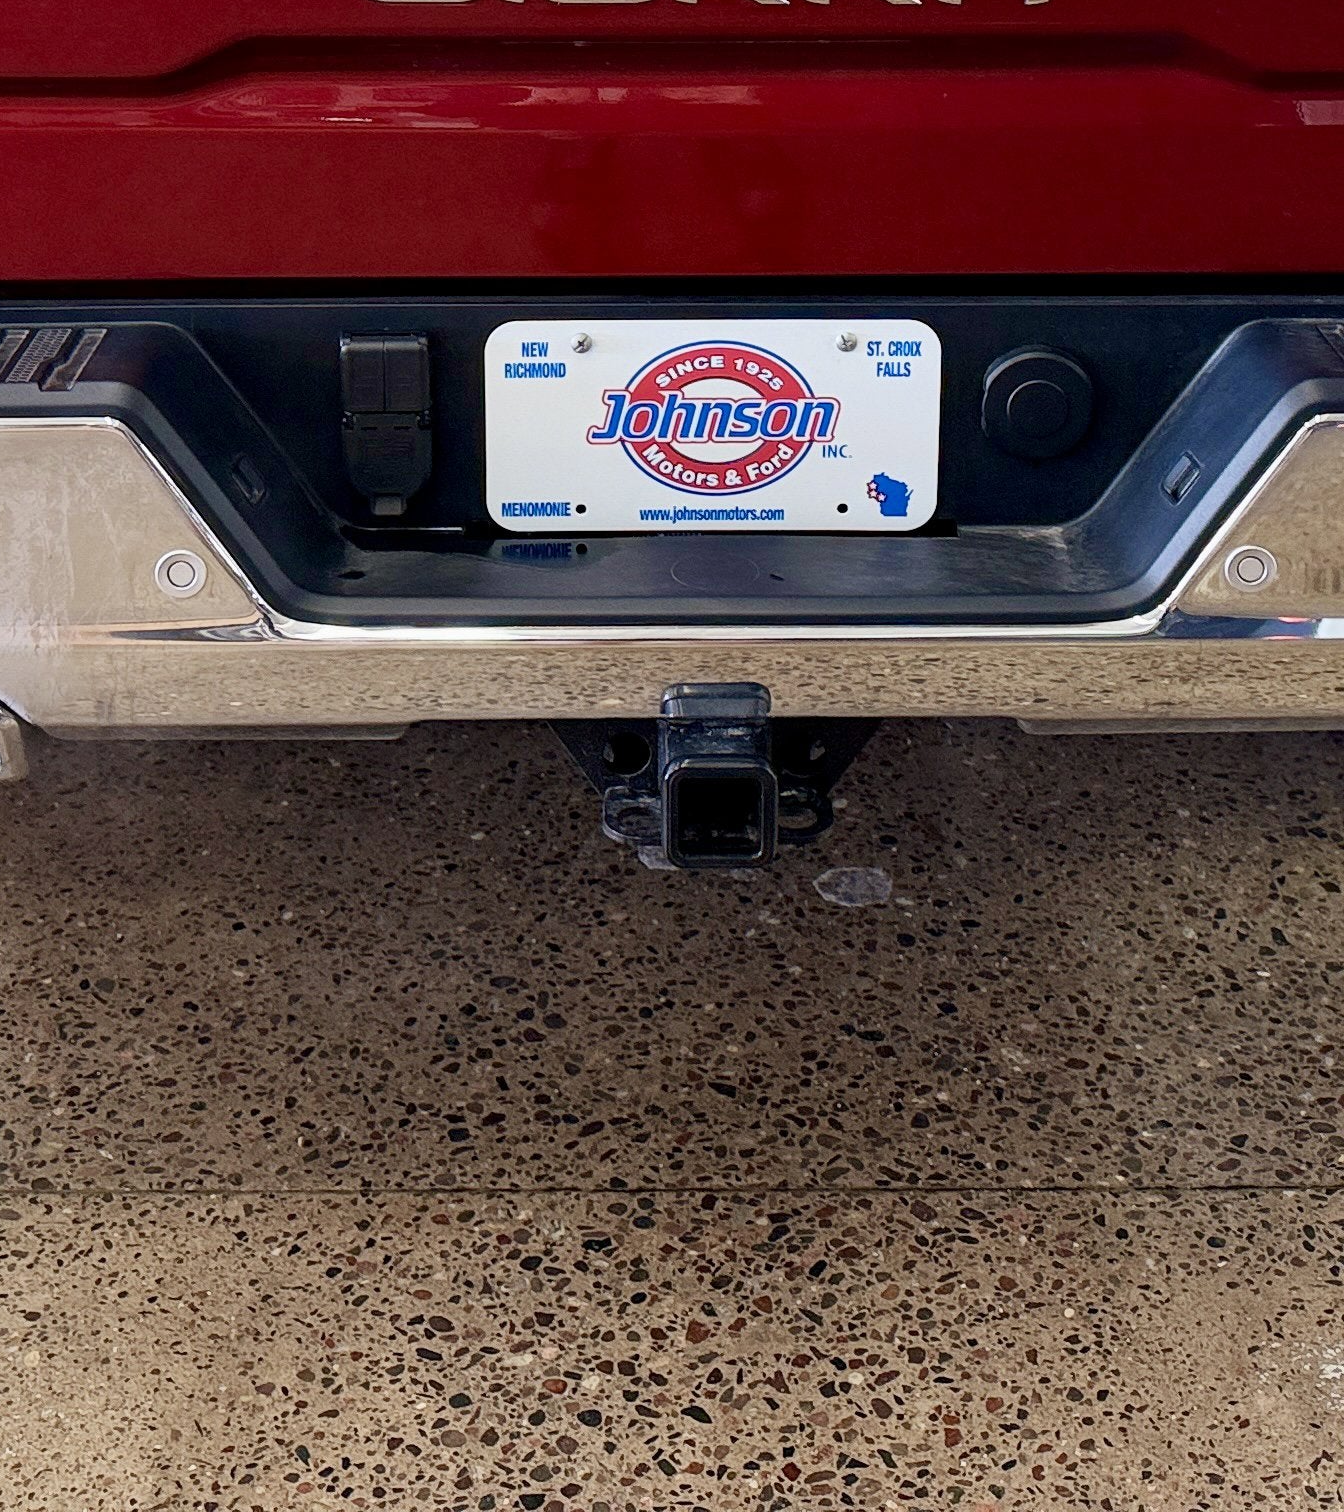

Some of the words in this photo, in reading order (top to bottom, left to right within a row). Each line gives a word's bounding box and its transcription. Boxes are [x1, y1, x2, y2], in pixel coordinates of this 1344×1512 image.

[521, 341, 549, 358] NEW
[866, 341, 885, 357] ST.
[887, 340, 922, 357] CROIX
[504, 362, 567, 379] RICHMOND
[655, 355, 726, 389] SINCE
[733, 357, 785, 392] 1925
[876, 361, 911, 378] FALLS
[589, 392, 837, 441] Johnson
[822, 444, 853, 459] INC.
[641, 443, 720, 488] Motors
[724, 468, 744, 487] &
[745, 442, 795, 482] Ford
[501, 501, 572, 518] MENOMONIE
[639, 505, 785, 524] www.johnsonmotors.com
